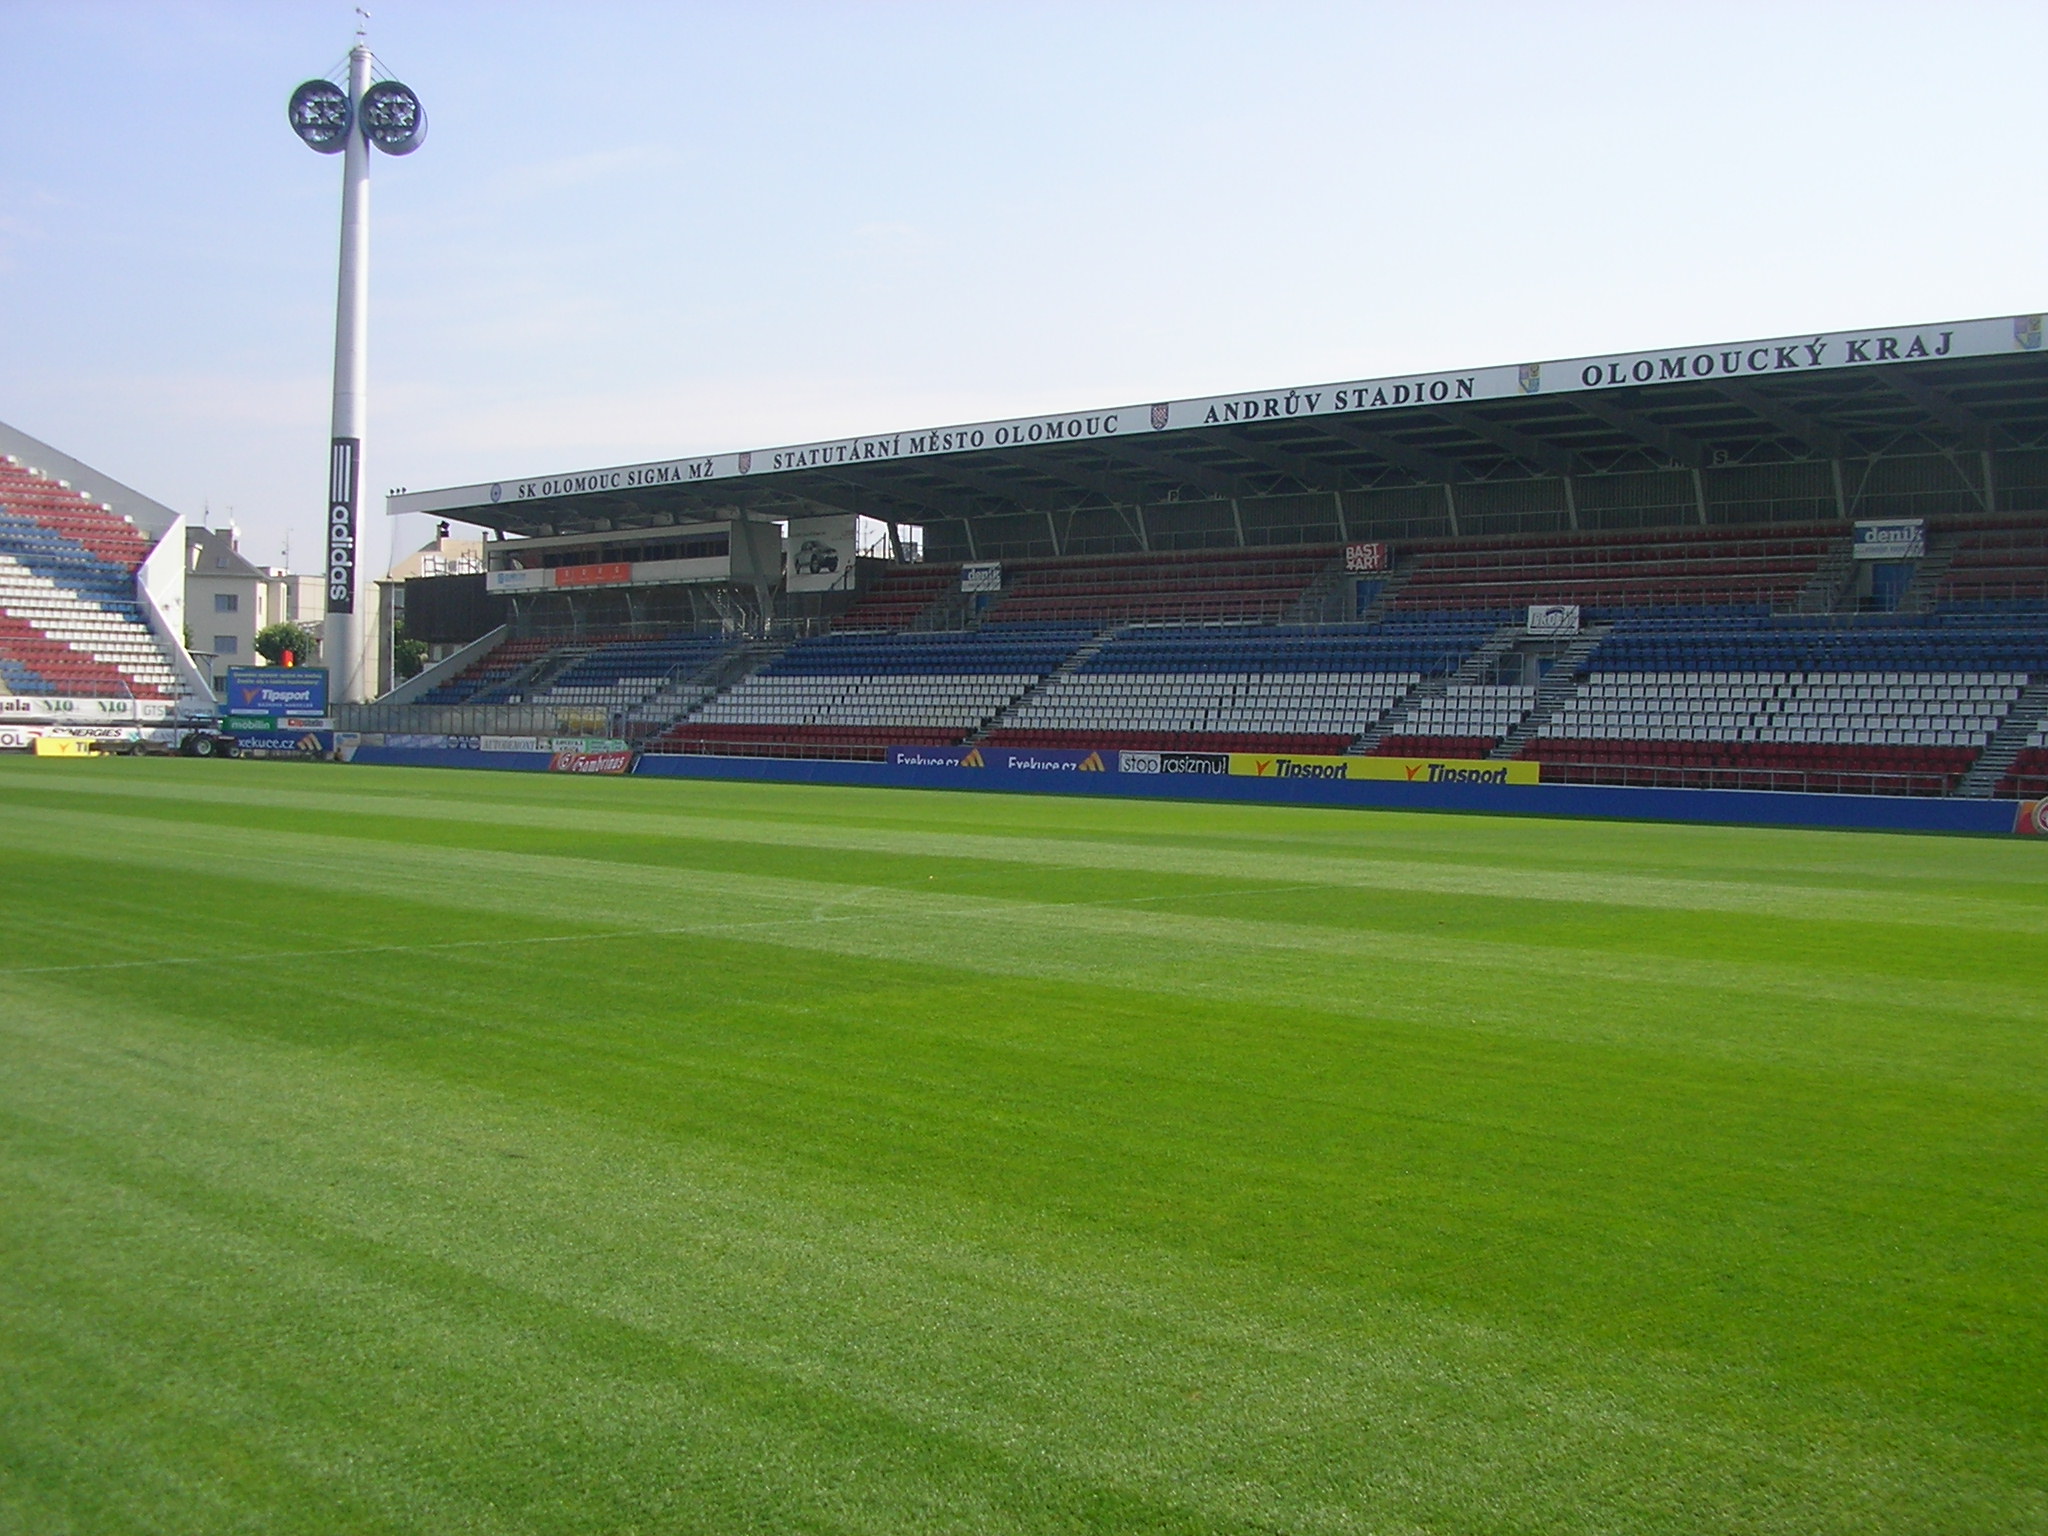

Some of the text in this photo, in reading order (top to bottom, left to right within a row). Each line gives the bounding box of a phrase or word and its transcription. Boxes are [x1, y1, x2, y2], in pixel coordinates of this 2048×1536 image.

[1581, 331, 1954, 387] OLOMOUCKÝ KRAJ
[1204, 377, 1475, 424] ANDRŮV STADION
[773, 415, 1119, 469] STATUTÁRNÍ MĚSTO OLOMOUC
[518, 458, 714, 499] SK OLOMOUC SIGMA MŽ
[330, 505, 354, 601] adidas
[1346, 543, 1380, 560] BAST
[261, 689, 310, 702] Tipsport
[0, 698, 31, 714] ala
[143, 705, 164, 716] GTS
[238, 736, 296, 750] xekuce.cz
[1123, 755, 1227, 775] stop rasizmu!
[1276, 759, 1348, 779] Tipsport
[1428, 764, 1508, 784] Tipsport
